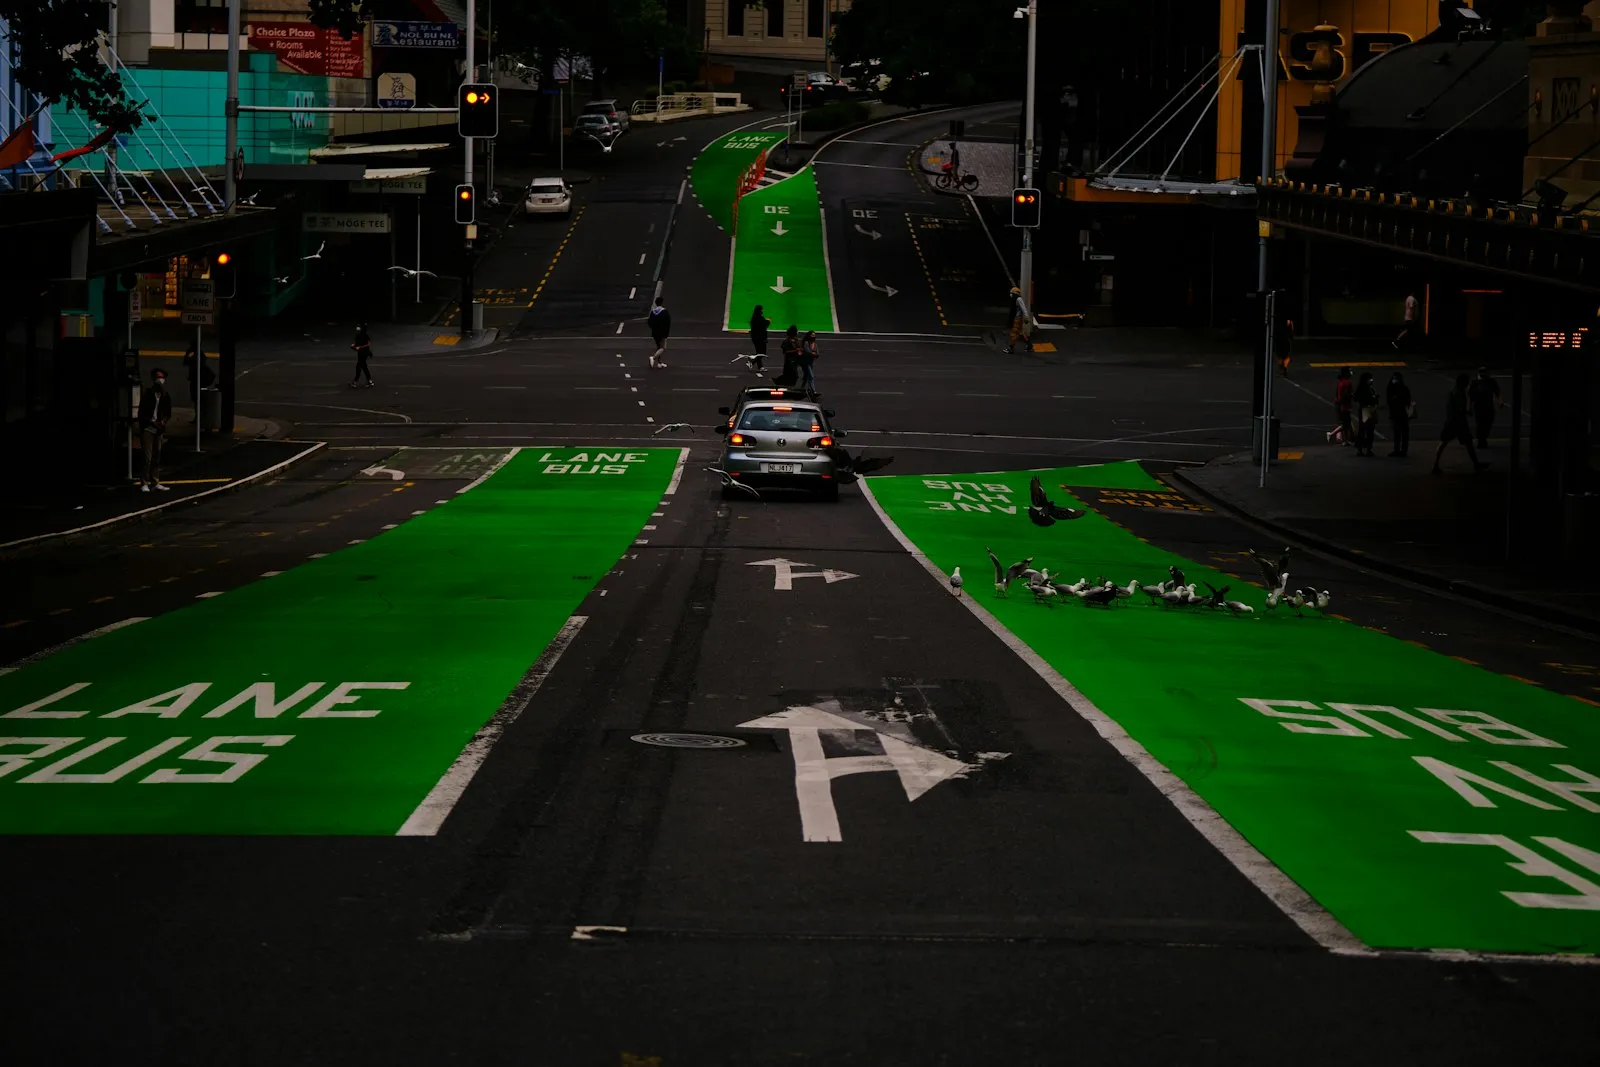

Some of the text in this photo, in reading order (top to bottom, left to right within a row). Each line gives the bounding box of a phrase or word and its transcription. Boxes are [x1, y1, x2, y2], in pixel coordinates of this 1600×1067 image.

[256, 27, 316, 37] Choice Plaza
[276, 41, 303, 49] Rooms
[287, 50, 322, 58] Available
[368, 220, 385, 229] TEE
[187, 299, 209, 307] LANE
[538, 453, 649, 463] LANE
[541, 464, 629, 475] BUS
[0, 681, 412, 719] LANE
[1236, 697, 1568, 749] BUS
